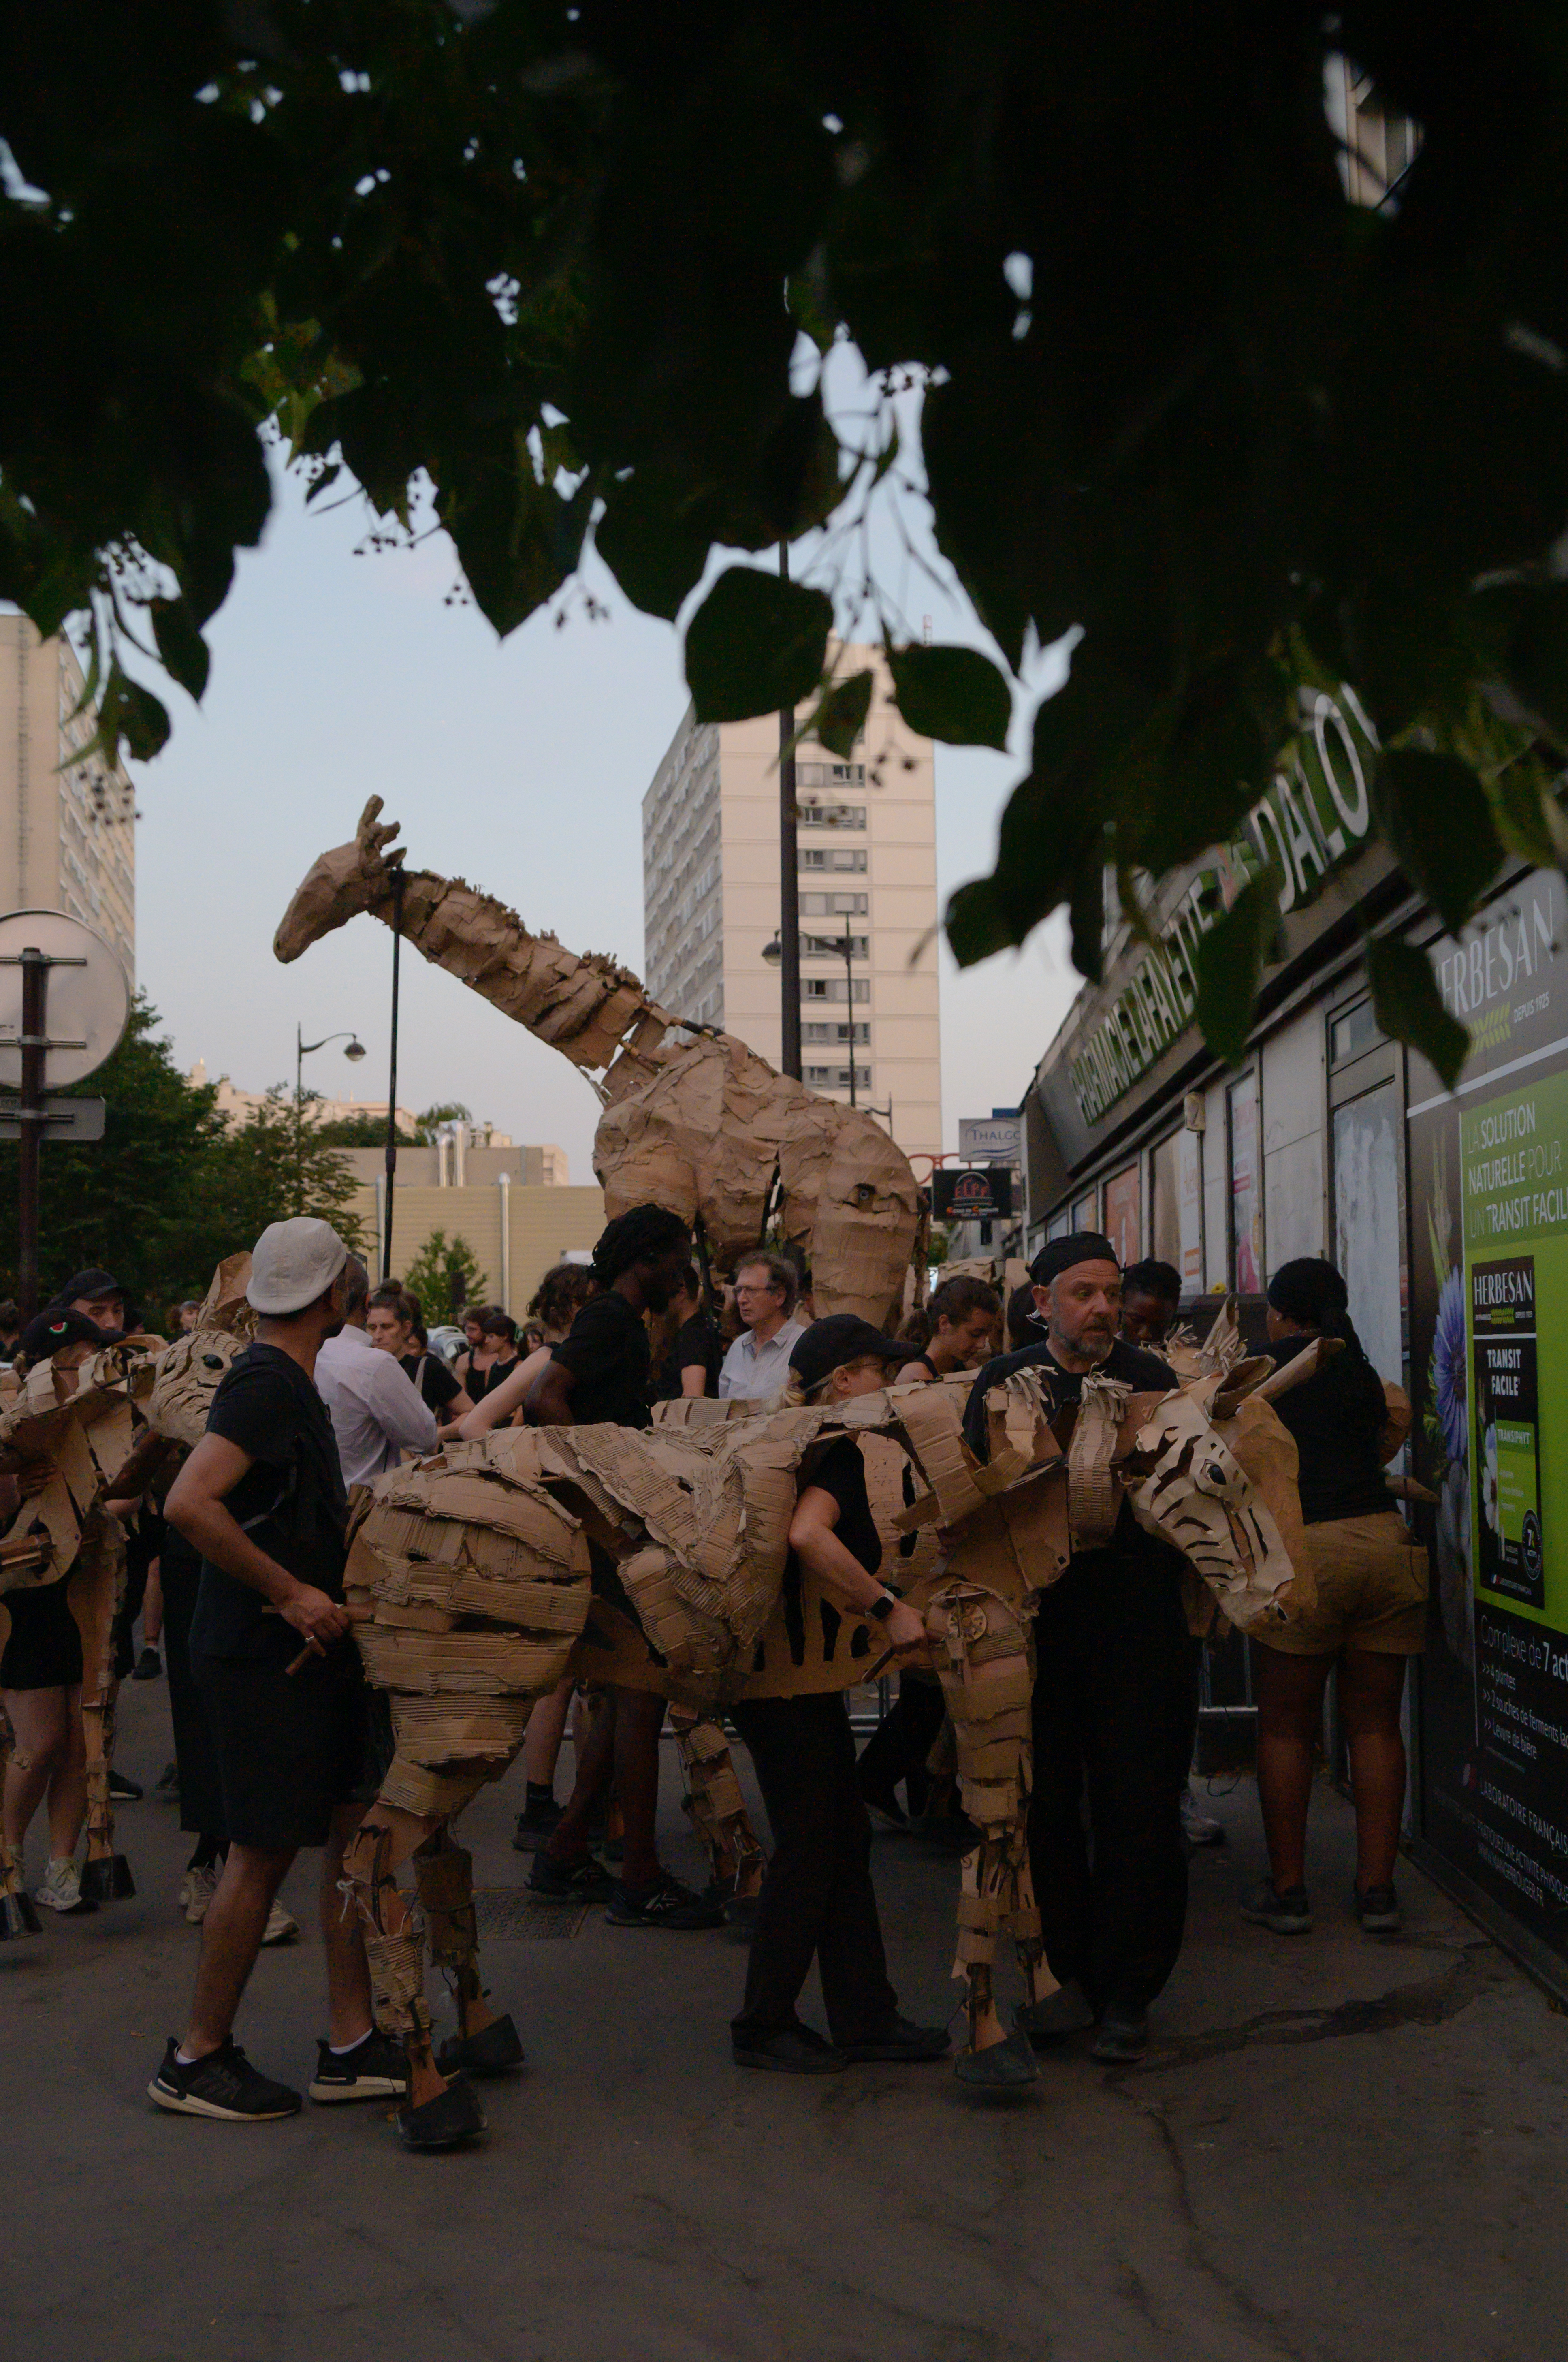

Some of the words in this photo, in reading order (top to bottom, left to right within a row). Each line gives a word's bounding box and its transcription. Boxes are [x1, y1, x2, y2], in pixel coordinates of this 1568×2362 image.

[1435, 888, 1553, 1018] ERBESAN
[1514, 999, 1534, 1023] DEPUIS
[1069, 999, 1141, 1128] PHARMACIE
[1468, 1124, 1481, 1154] LA
[1481, 1101, 1536, 1149] SOLUTION
[1468, 1151, 1526, 1195] NATURELLE
[1528, 1140, 1562, 1180] POUR
[1470, 1209, 1485, 1238] UN
[1486, 1196, 1531, 1234] TRANSIT
[1533, 1185, 1568, 1225] FACIL
[1474, 1269, 1532, 1305] HERBESAN
[1487, 1348, 1521, 1369] TRANSIT
[1491, 1375, 1519, 1396] FACILE
[1481, 1615, 1527, 1663] Complexe
[1528, 1635, 1542, 1669] de
[1543, 1641, 1550, 1672] 7
[1490, 1663, 1495, 1680] 4
[1495, 1665, 1516, 1691] plantes
[1491, 1689, 1495, 1708] 2
[1495, 1697, 1519, 1721] souches
[1519, 1705, 1528, 1726] de
[1528, 1709, 1559, 1744] ferments
[1492, 1718, 1512, 1744] Levure
[1512, 1729, 1521, 1750] de
[1521, 1733, 1537, 1760] bière
[1479, 1777, 1527, 1826] LABORATOIRE
[1528, 1810, 1568, 1855] FRANÇAIS
